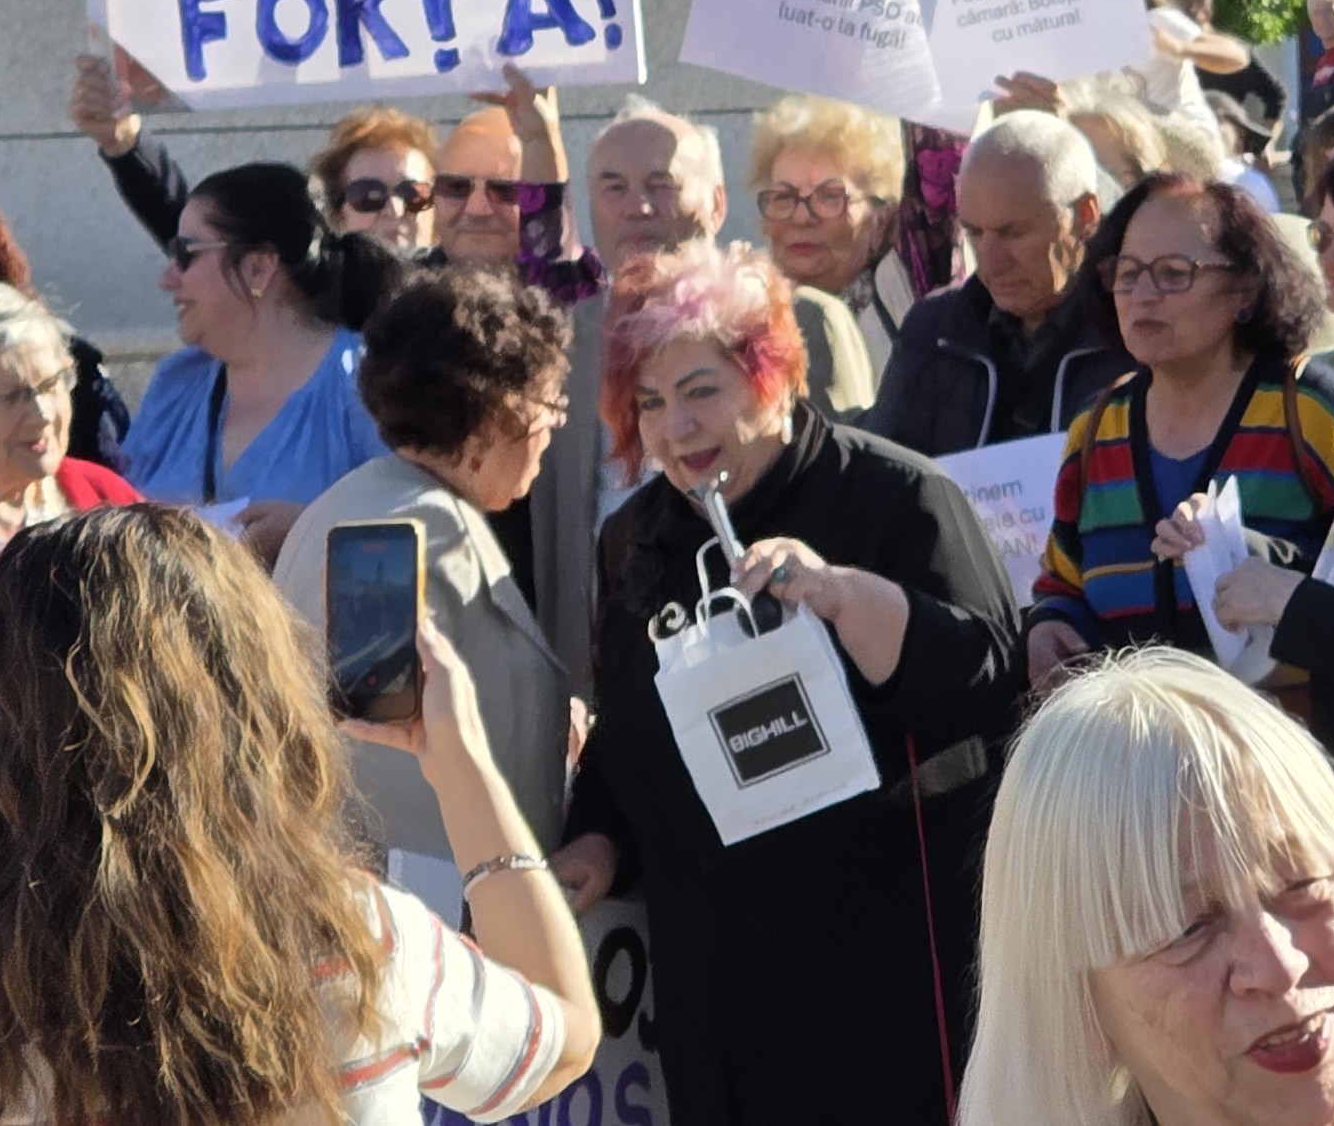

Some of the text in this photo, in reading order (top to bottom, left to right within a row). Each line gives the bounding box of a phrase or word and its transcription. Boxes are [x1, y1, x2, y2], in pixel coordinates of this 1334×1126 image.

[778, 0, 907, 50] luat-o la fugă!
[991, 27, 1014, 43] cu
[1019, 506, 1045, 524] cu
[728, 710, 808, 754] BIGHILL
